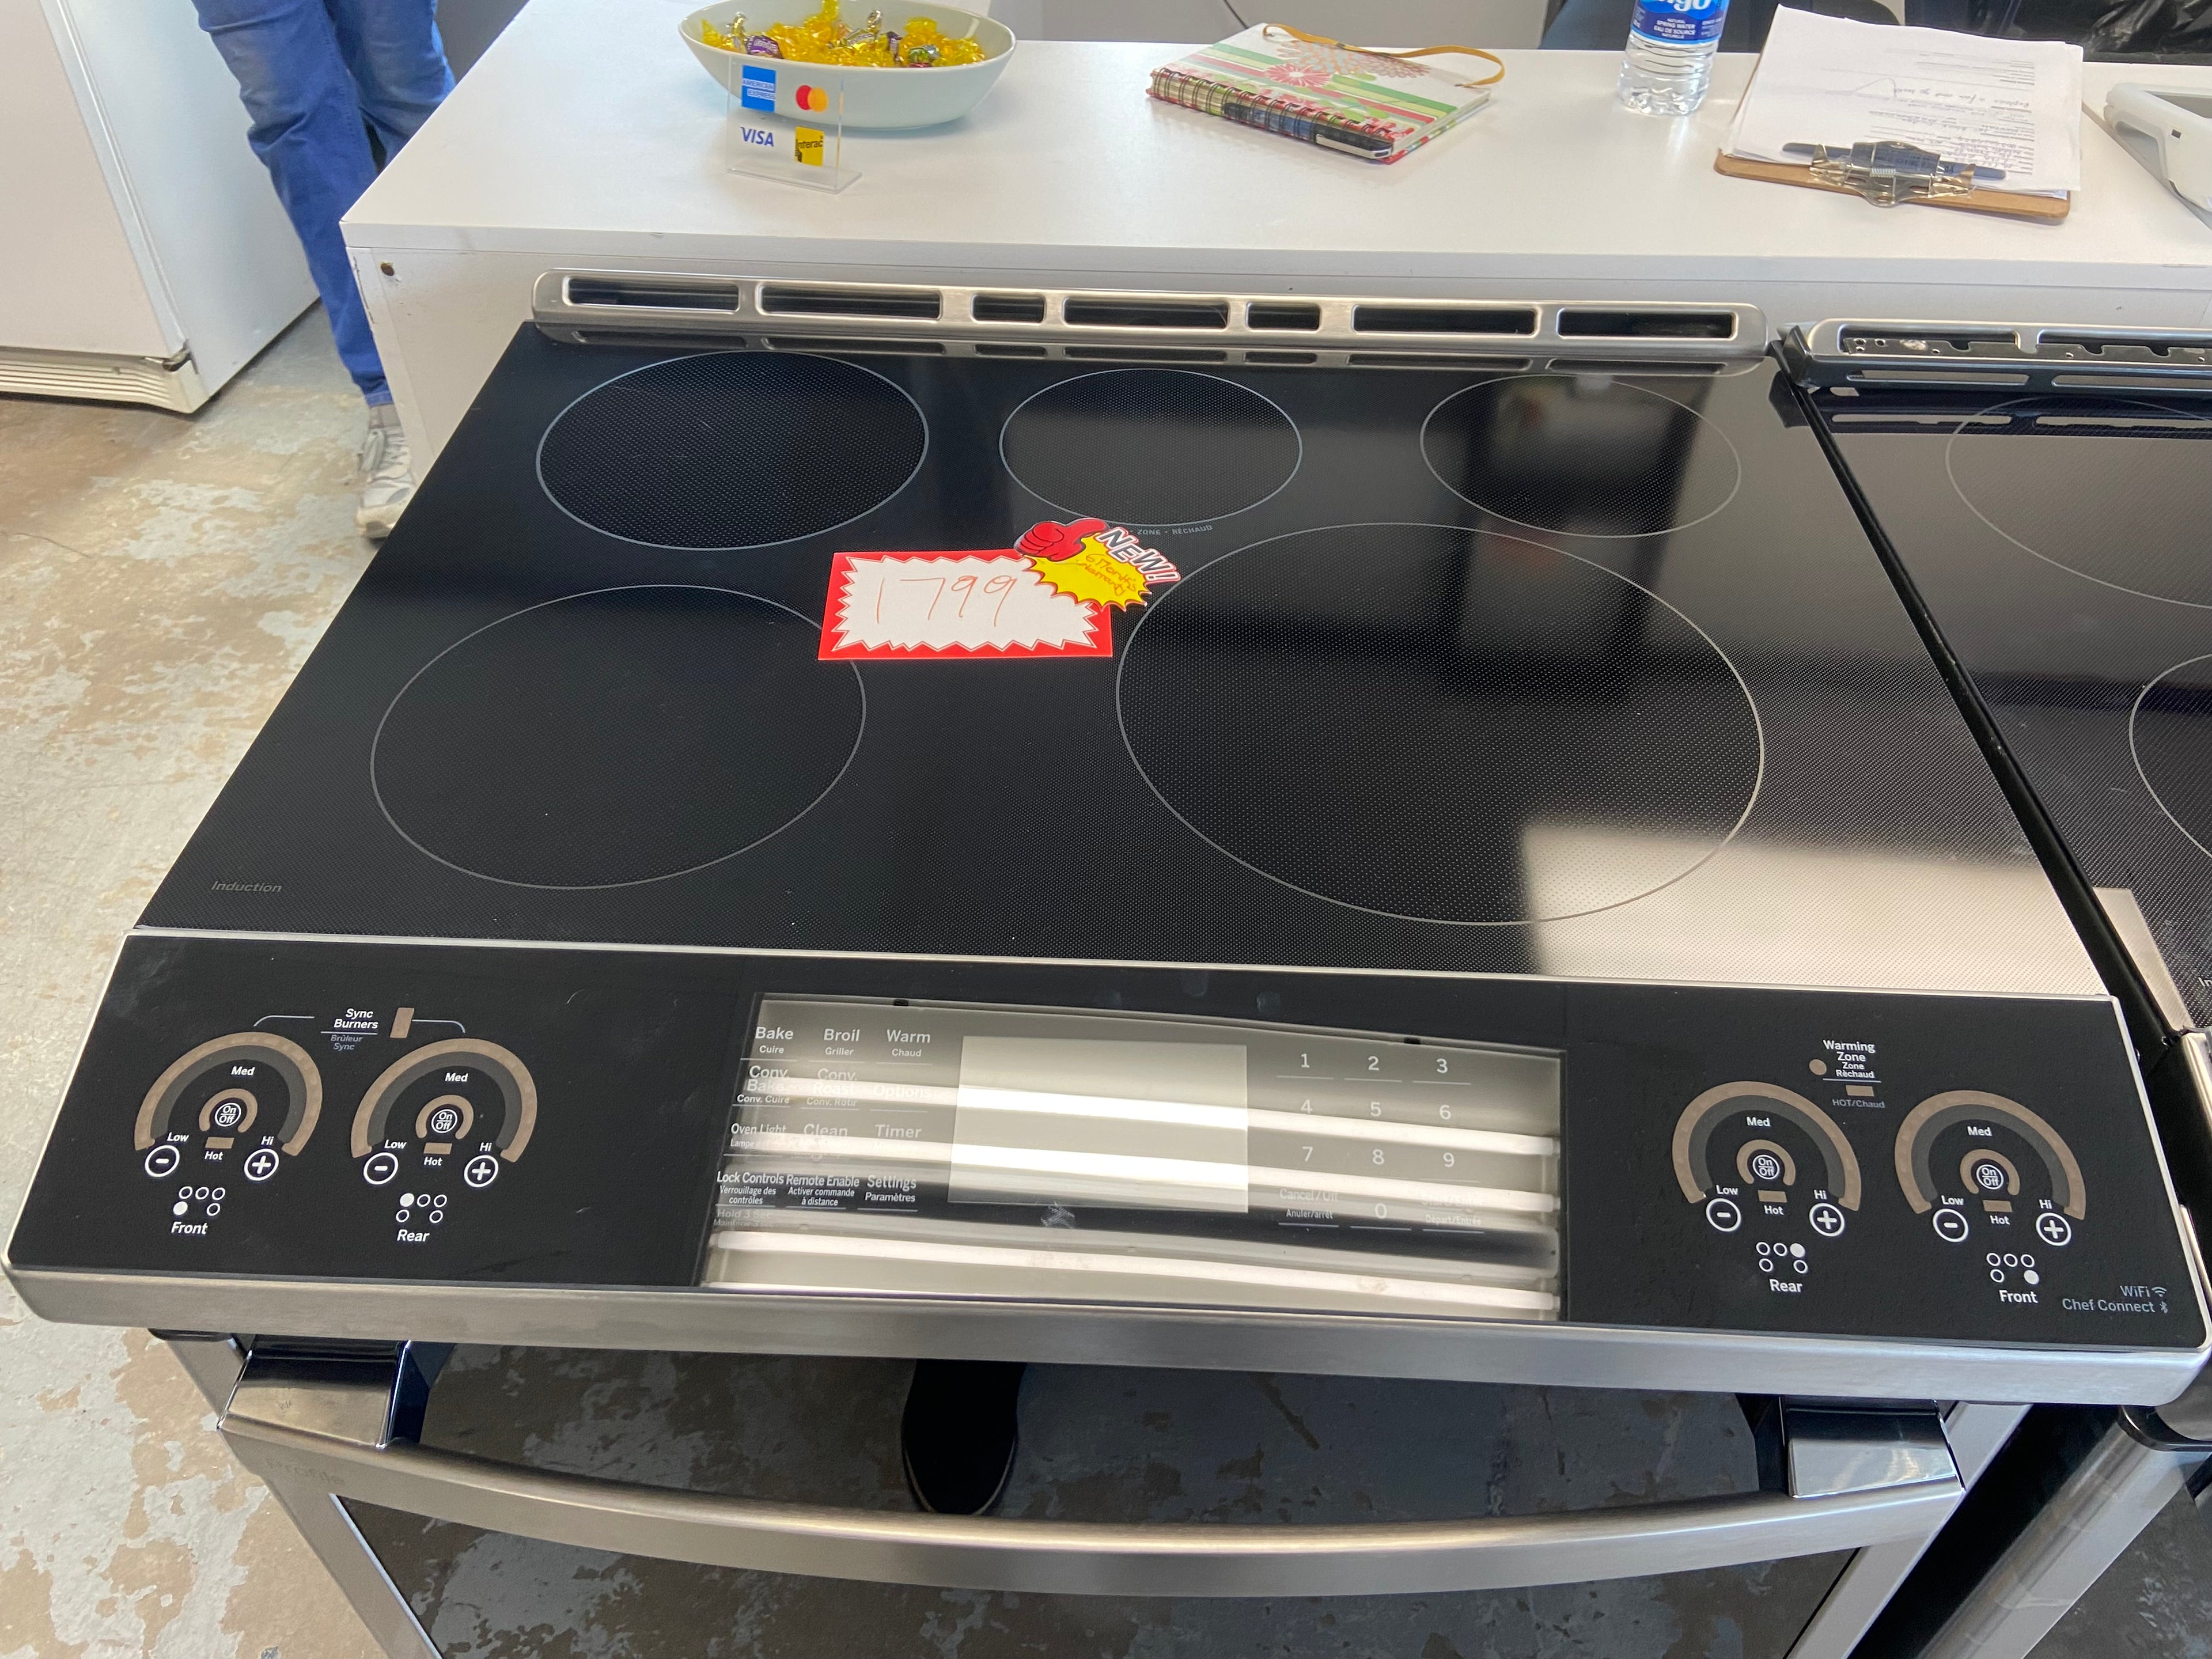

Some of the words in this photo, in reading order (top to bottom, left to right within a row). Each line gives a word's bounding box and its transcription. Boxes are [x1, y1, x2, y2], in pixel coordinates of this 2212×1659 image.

[743, 79, 774, 89] AMERICAN
[748, 90, 775, 99] EXPRESS
[740, 127, 774, 147] VISA
[796, 139, 824, 149] Interac
[1098, 529, 1177, 579] NEW!
[876, 575, 1017, 627] 1799
[211, 881, 282, 892] Induction
[345, 1008, 374, 1020] Sync
[334, 1018, 378, 1029] Burners
[331, 1034, 363, 1042] Brûleur
[755, 1027, 794, 1040] Bake
[824, 1028, 860, 1042] Broil
[887, 1029, 930, 1043] Warm
[333, 1042, 355, 1051] Sync
[759, 1045, 785, 1054] Cuire
[825, 1047, 854, 1056] Griller
[1823, 1040, 1876, 1054] Warming
[892, 1048, 922, 1057] Chaud
[1836, 1051, 1866, 1062] Zone
[1301, 1053, 1310, 1068] 1
[1368, 1056, 1380, 1071] 2
[1436, 1058, 1448, 1073] 3
[1842, 1062, 1865, 1070] Zone
[231, 1066, 255, 1075] Med
[749, 1065, 789, 1078] Conv.
[817, 1068, 858, 1081] Conv.
[445, 1073, 468, 1082] Med
[737, 1094, 763, 1103] Conv.
[765, 1095, 790, 1104] Cuire
[806, 1097, 832, 1106] Conv.
[1832, 1099, 1885, 1108] HOT/Chaud
[222, 1105, 237, 1114] On
[1301, 1099, 1313, 1113] 4
[1370, 1101, 1381, 1116] 5
[439, 1112, 453, 1120] On
[1439, 1104, 1452, 1120] 6
[219, 1115, 235, 1123] Off
[435, 1119, 450, 1129] Off
[1746, 1116, 1771, 1127] Med
[731, 1123, 757, 1134] Oven
[760, 1124, 787, 1136] Light
[803, 1123, 848, 1137] Clean
[876, 1124, 922, 1138] Timer
[1967, 1126, 1993, 1137] Med
[166, 1132, 190, 1142] Low
[261, 1136, 274, 1146] Hi
[384, 1139, 407, 1149] Low
[479, 1142, 493, 1152] Hi
[730, 1139, 754, 1149] Lampe
[204, 1150, 224, 1161] Hot
[1302, 1146, 1313, 1162] 7
[1372, 1149, 1385, 1165] 8
[423, 1156, 443, 1166] Hot
[1443, 1152, 1455, 1168] 9
[1758, 1157, 1774, 1166] On
[717, 1171, 741, 1183] Lock
[742, 1172, 784, 1184] Controls
[1759, 1168, 1774, 1176] Off
[1982, 1168, 1997, 1176] On
[786, 1174, 824, 1186] Remote
[827, 1176, 859, 1187] Enable
[867, 1175, 916, 1192] Settings
[1982, 1177, 1998, 1186] Off
[720, 1184, 762, 1195] Verrouillage
[763, 1186, 777, 1195] des
[787, 1186, 814, 1195] Activer
[815, 1188, 855, 1197] commande
[1716, 1184, 1738, 1195] Low
[1813, 1190, 1827, 1200] Hi
[729, 1196, 763, 1205] contrôles
[801, 1196, 806, 1205] à
[807, 1196, 838, 1206] distance
[865, 1192, 915, 1202] Paramètres
[1941, 1195, 1964, 1206] Low
[2039, 1199, 2052, 1209] Hi
[717, 1209, 741, 1217] Hold
[744, 1210, 750, 1218] 3
[1374, 1202, 1388, 1218] 0
[1764, 1205, 1784, 1215] Hot
[1990, 1215, 2010, 1225] Hot
[171, 1221, 208, 1235] Front
[396, 1229, 430, 1242] Rear
[1769, 1279, 1802, 1293] Rear
[2119, 1285, 2150, 1297] WiFi
[1999, 1290, 2039, 1304] Front
[2062, 1298, 2094, 1310] Chef
[2097, 1299, 2156, 1313] Connect
